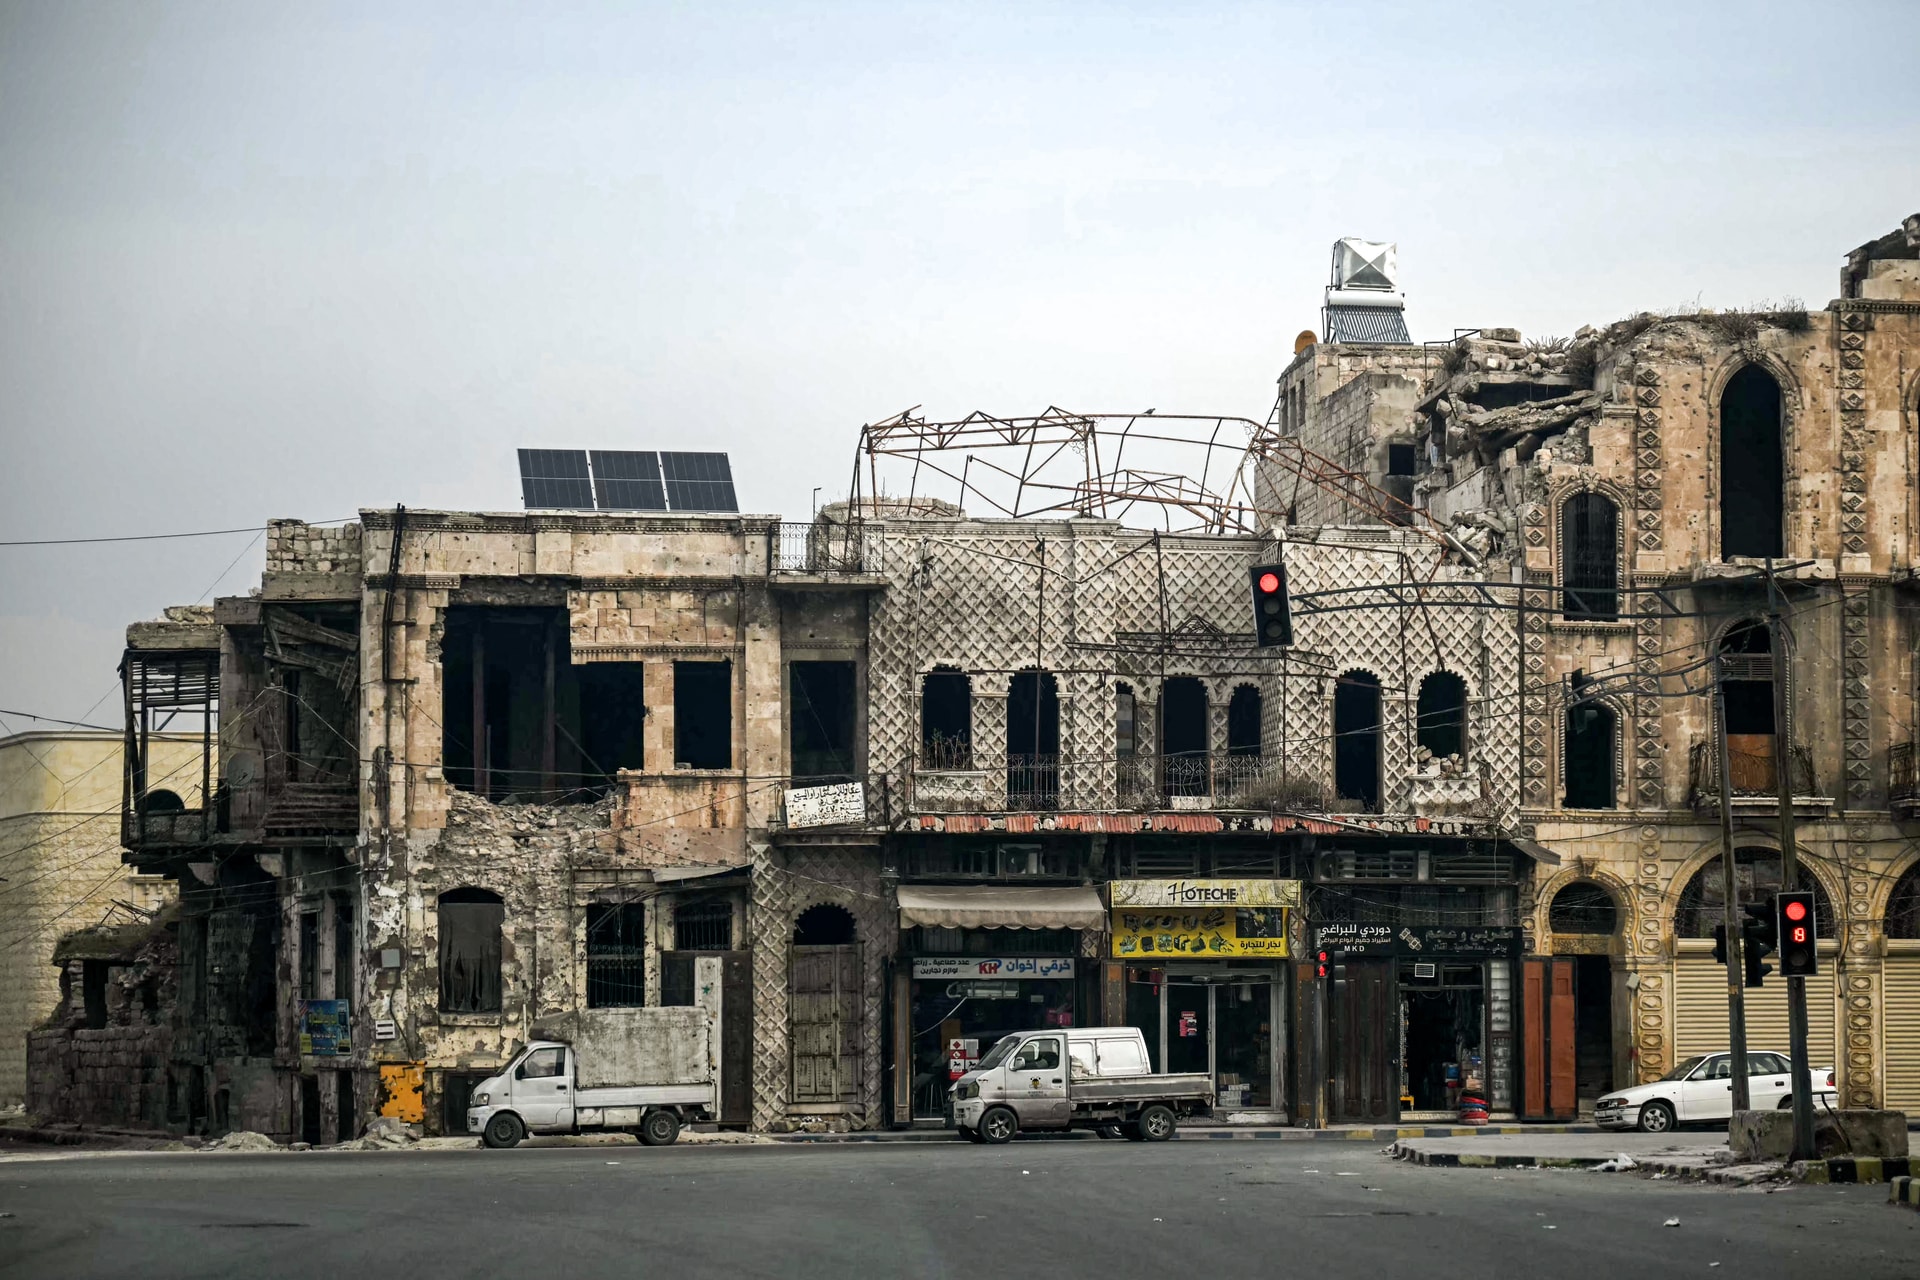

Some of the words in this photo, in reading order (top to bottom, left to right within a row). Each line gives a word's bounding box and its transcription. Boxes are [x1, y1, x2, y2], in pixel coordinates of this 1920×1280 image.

[1320, 924, 1357, 937] للبراغي
[1360, 926, 1391, 937] دوردي
[1240, 941, 1265, 950] للتجارة
[978, 963, 999, 974] KH
[1006, 958, 1037, 973] إخوان
